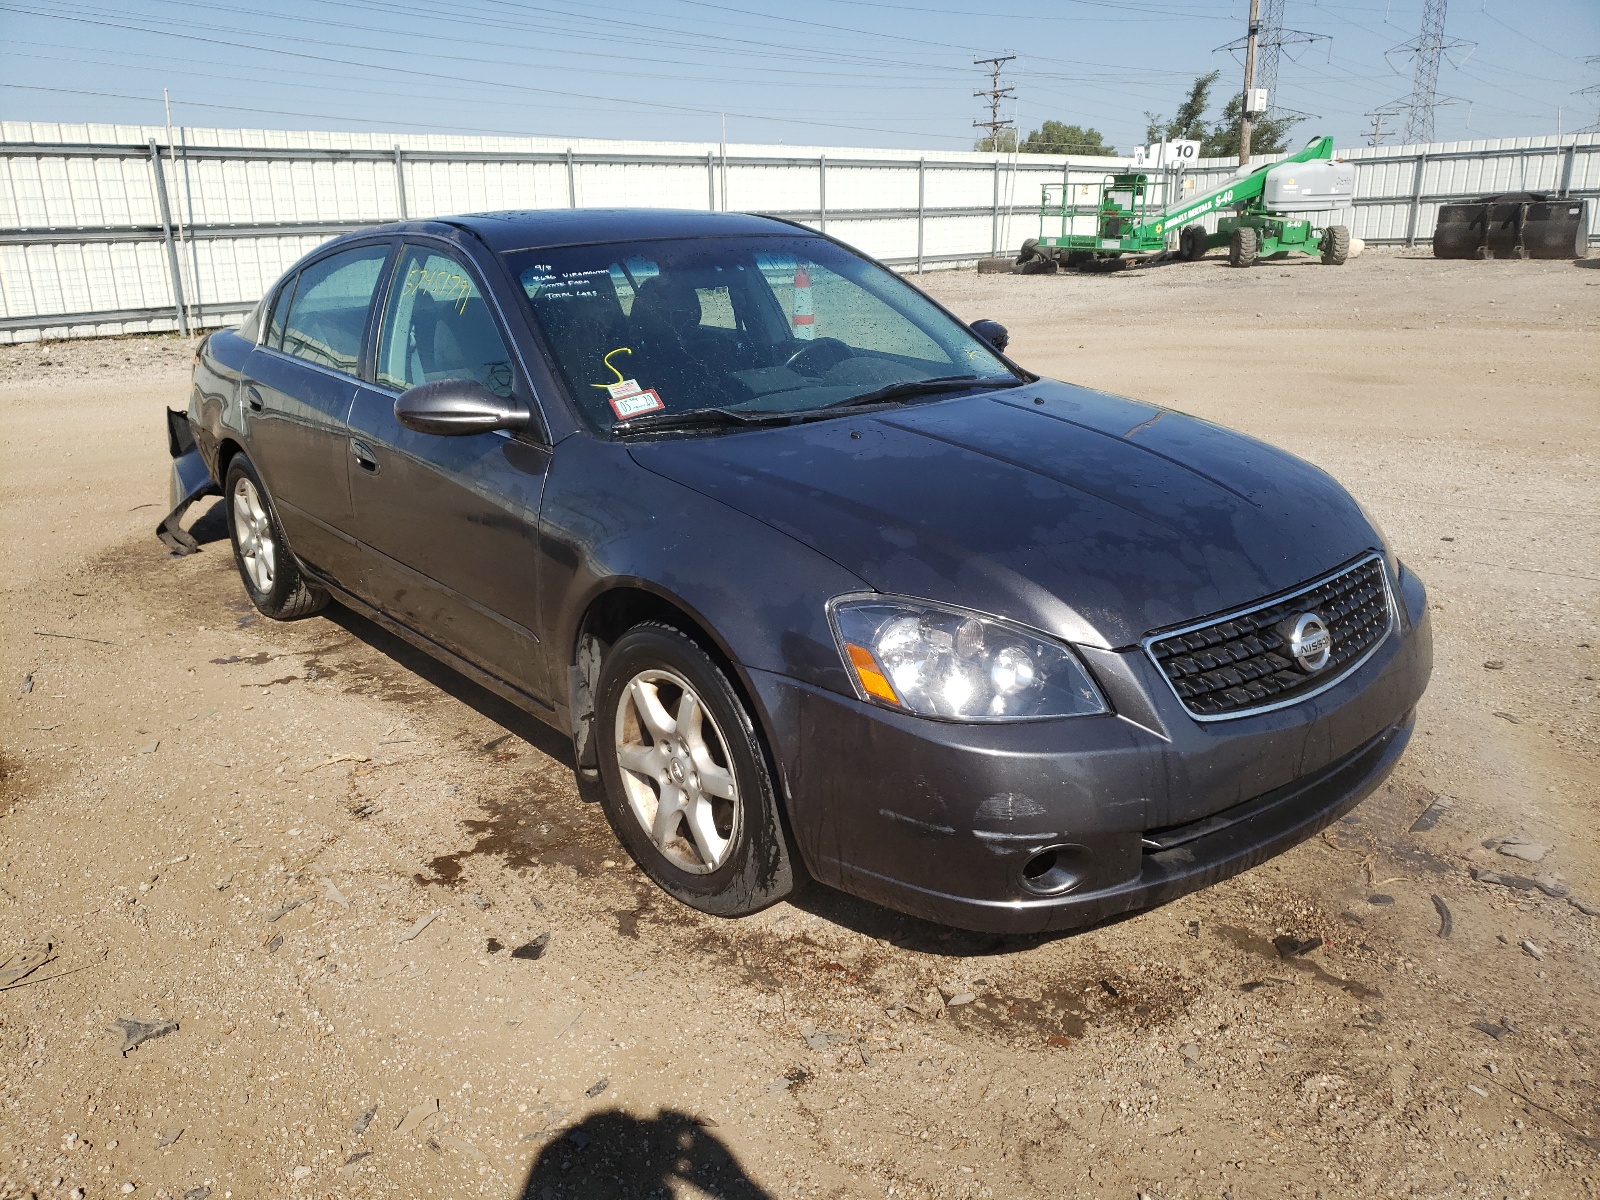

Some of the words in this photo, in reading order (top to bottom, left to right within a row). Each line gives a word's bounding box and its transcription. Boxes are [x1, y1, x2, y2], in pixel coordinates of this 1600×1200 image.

[1175, 144, 1194, 158] 10
[1215, 189, 1233, 207] S-40
[1286, 220, 1302, 228] S-40
